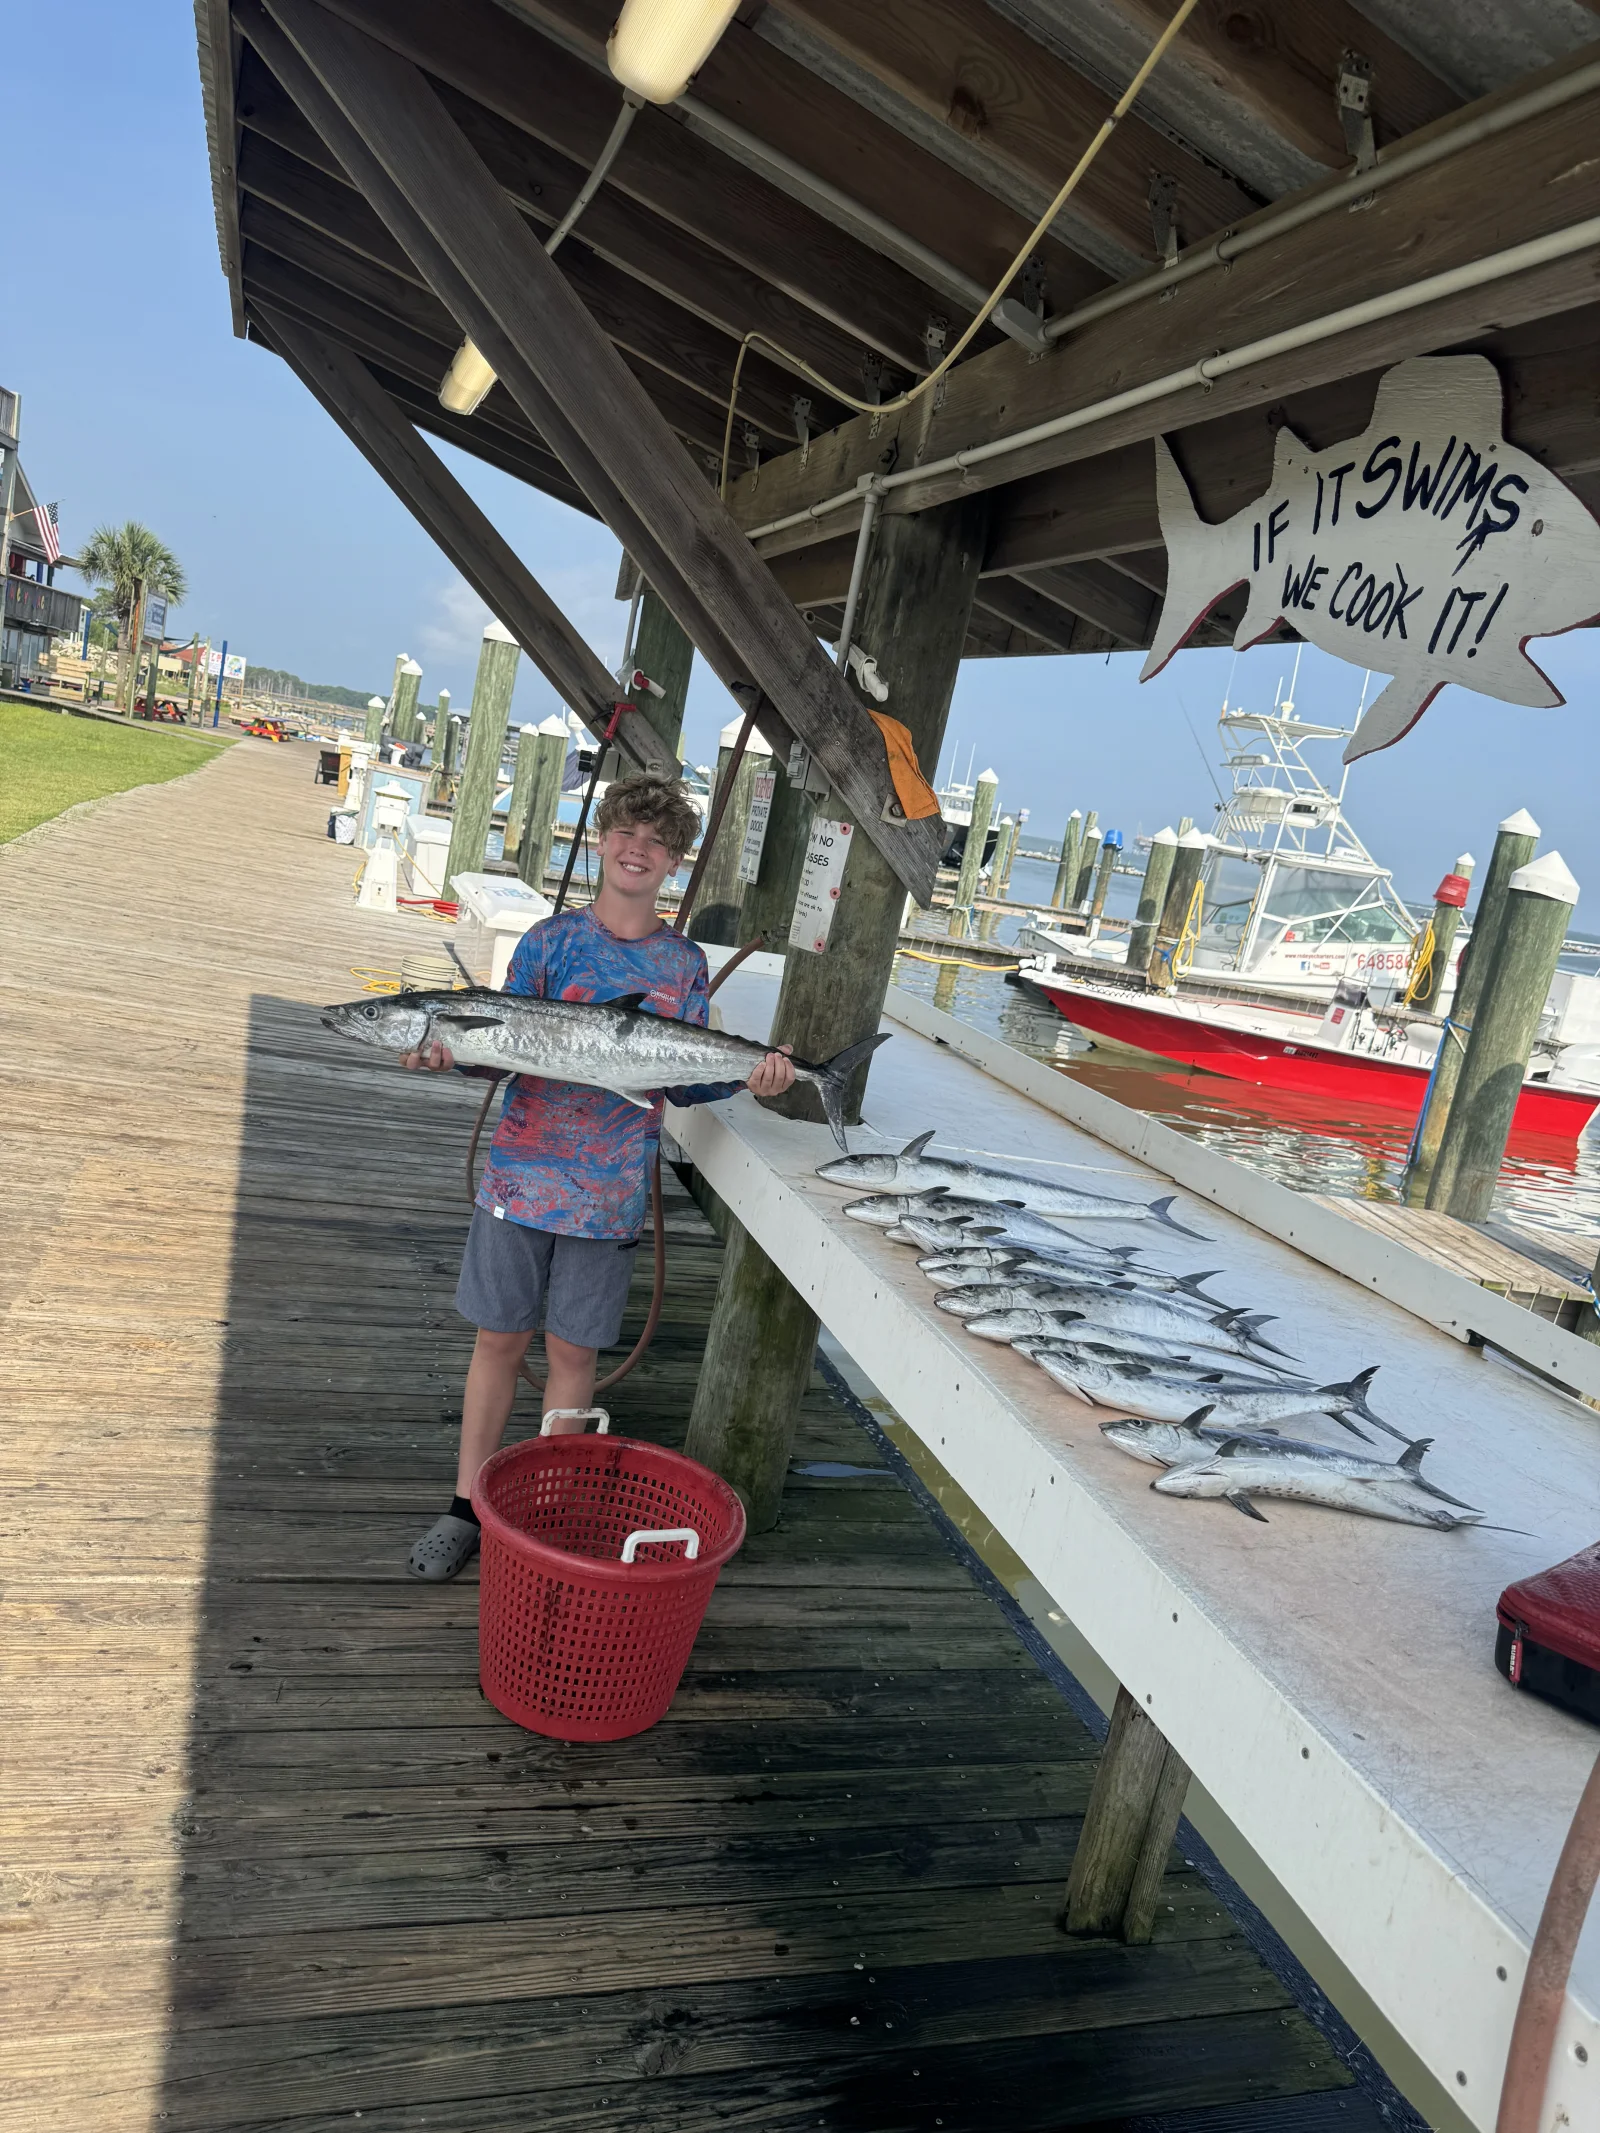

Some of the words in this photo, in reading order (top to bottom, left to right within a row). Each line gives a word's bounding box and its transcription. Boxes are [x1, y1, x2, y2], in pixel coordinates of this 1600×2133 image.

[1253, 499, 1290, 572] IF
[1312, 460, 1356, 535] IT
[1355, 435, 1529, 535] SWIMS
[1281, 554, 1329, 610] WE
[1328, 560, 1424, 640] COOK
[1427, 582, 1509, 659] IT!
[751, 805, 768, 819] PRIVATE
[750, 819, 764, 833] DOCKS
[819, 834, 834, 848] NO
